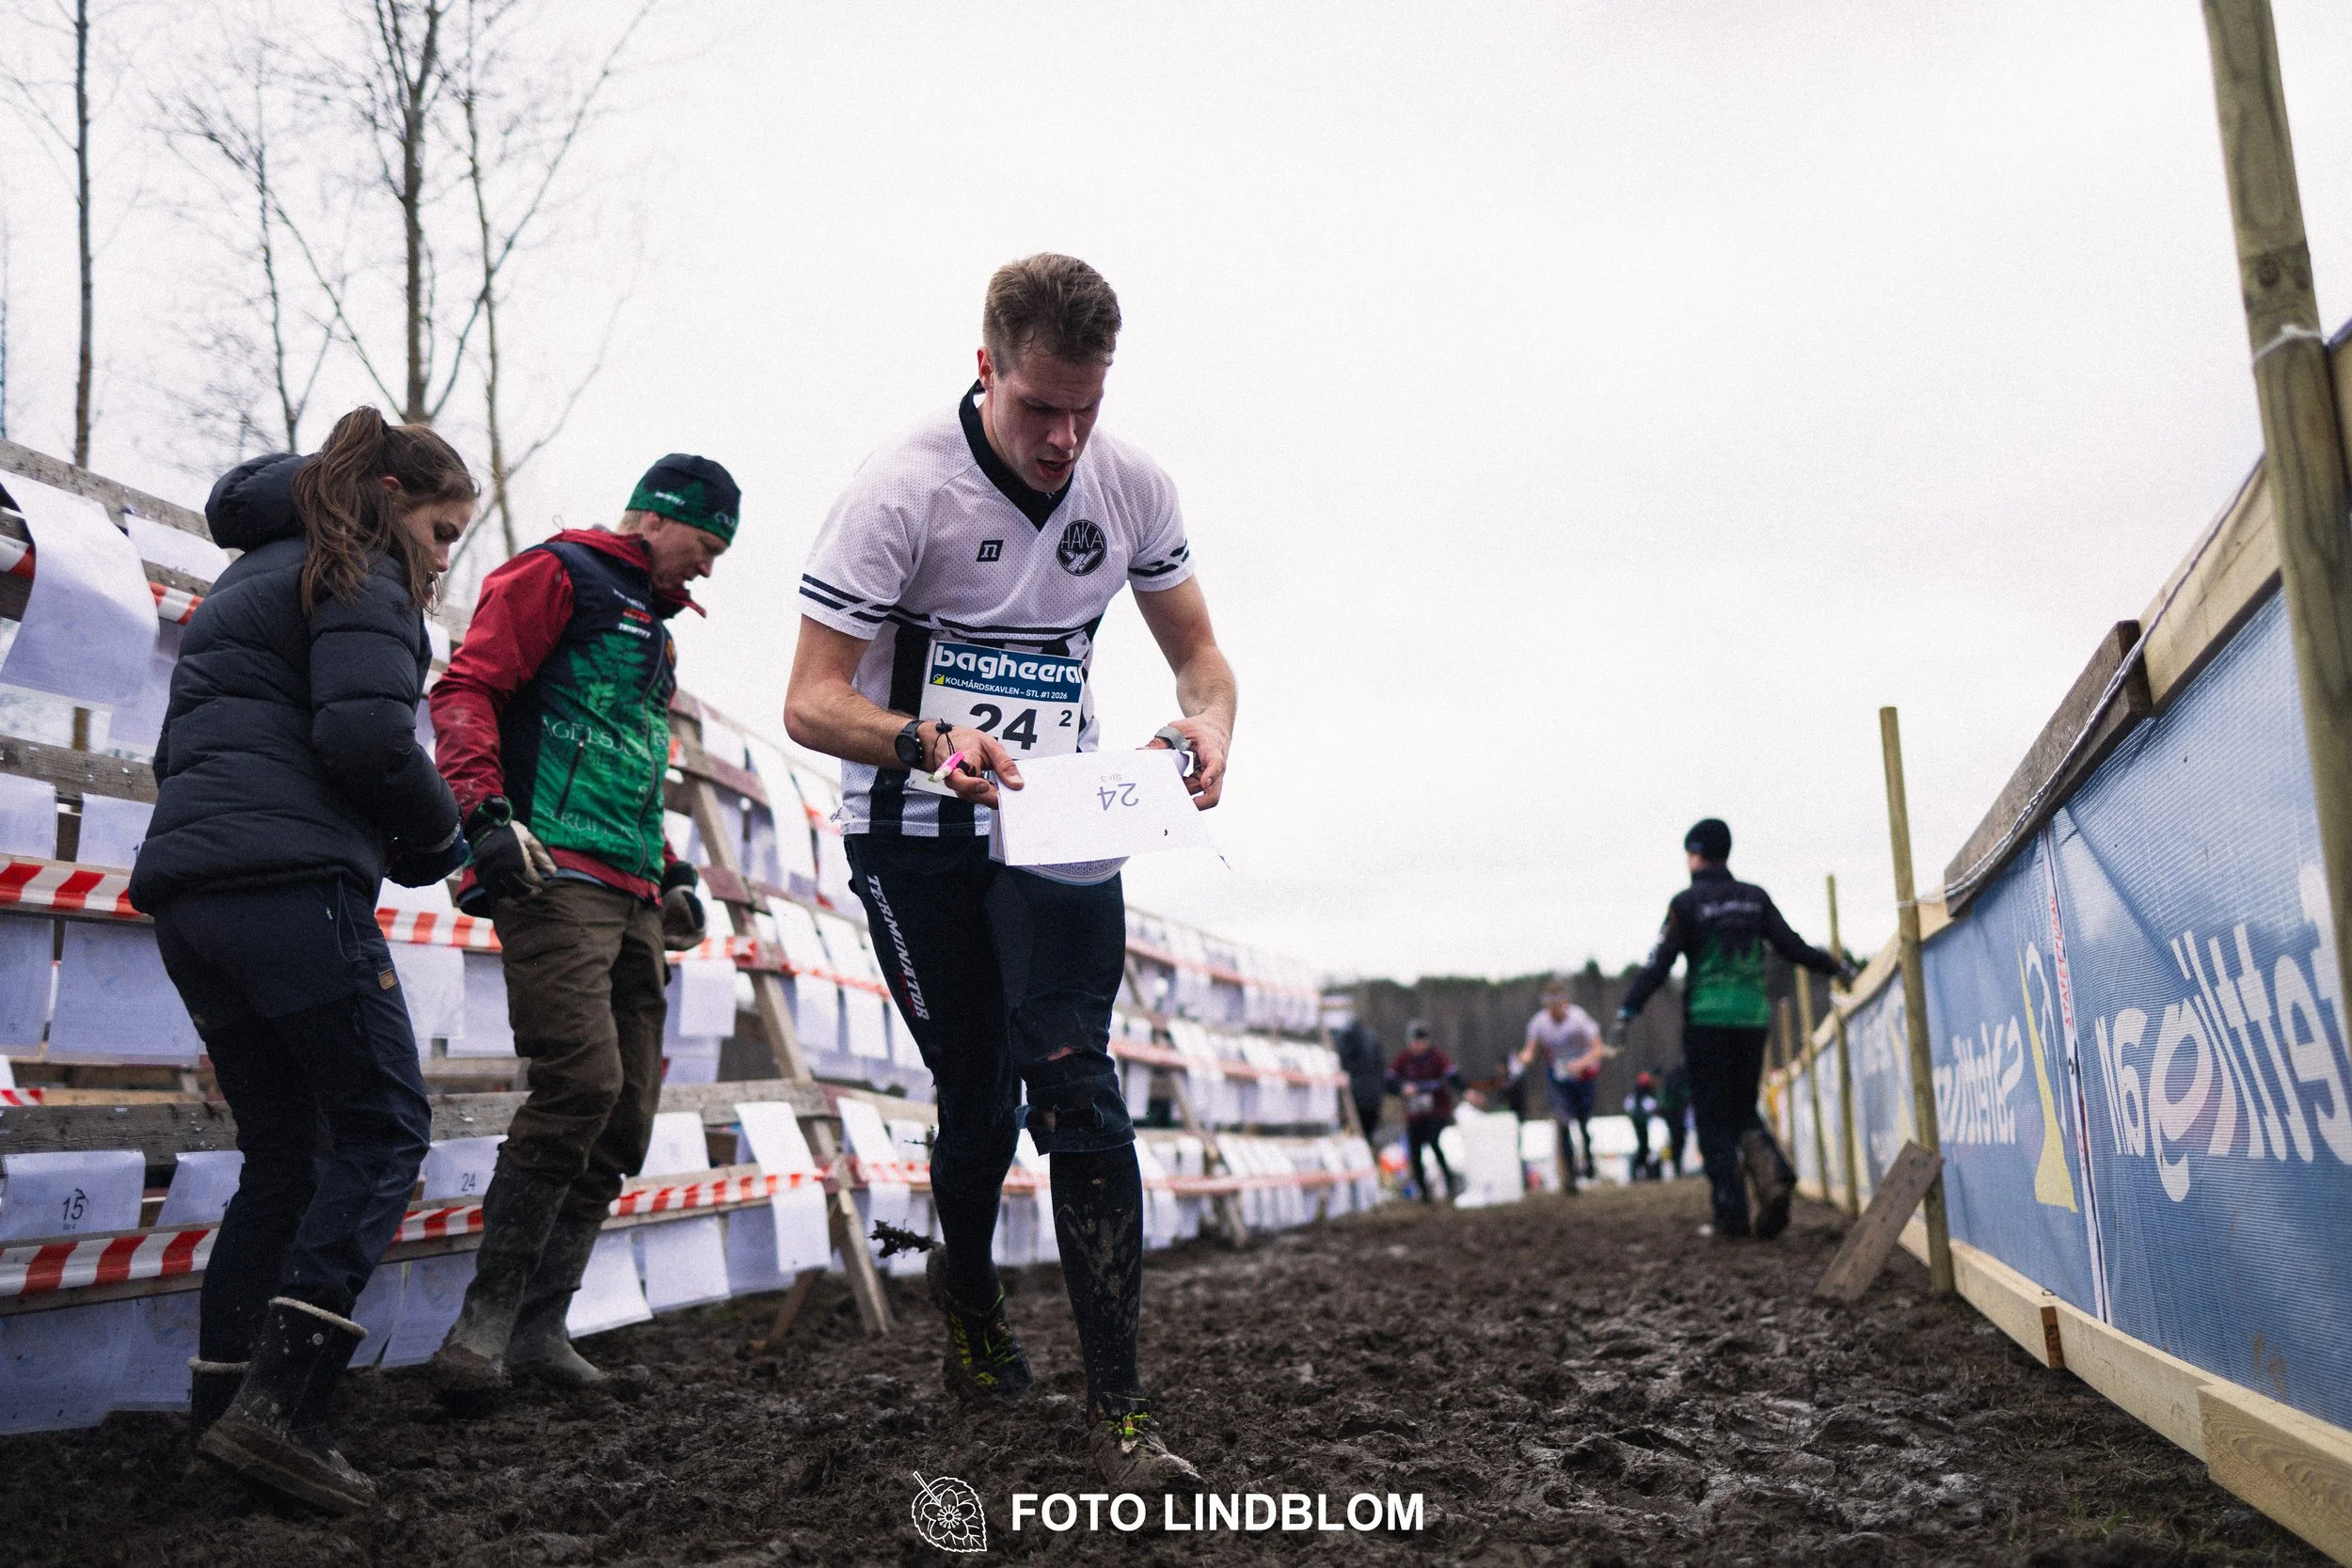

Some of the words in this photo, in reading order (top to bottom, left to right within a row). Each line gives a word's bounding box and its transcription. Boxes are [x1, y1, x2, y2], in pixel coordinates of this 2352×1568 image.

[1060, 521, 1104, 550] HAKA
[934, 644, 1082, 685] bagheera
[945, 675, 1020, 696] KOLMÅRDSKAVLEN
[1025, 689, 1040, 699] STL
[1041, 690, 1050, 700] #1
[1051, 690, 1068, 700] 2026
[969, 703, 1038, 751] 24
[1058, 709, 1073, 728] 2
[1096, 783, 1139, 811] 24
[866, 874, 930, 1021] TERMINATOR
[460, 1172, 477, 1192] 24
[62, 1196, 86, 1221] 15
